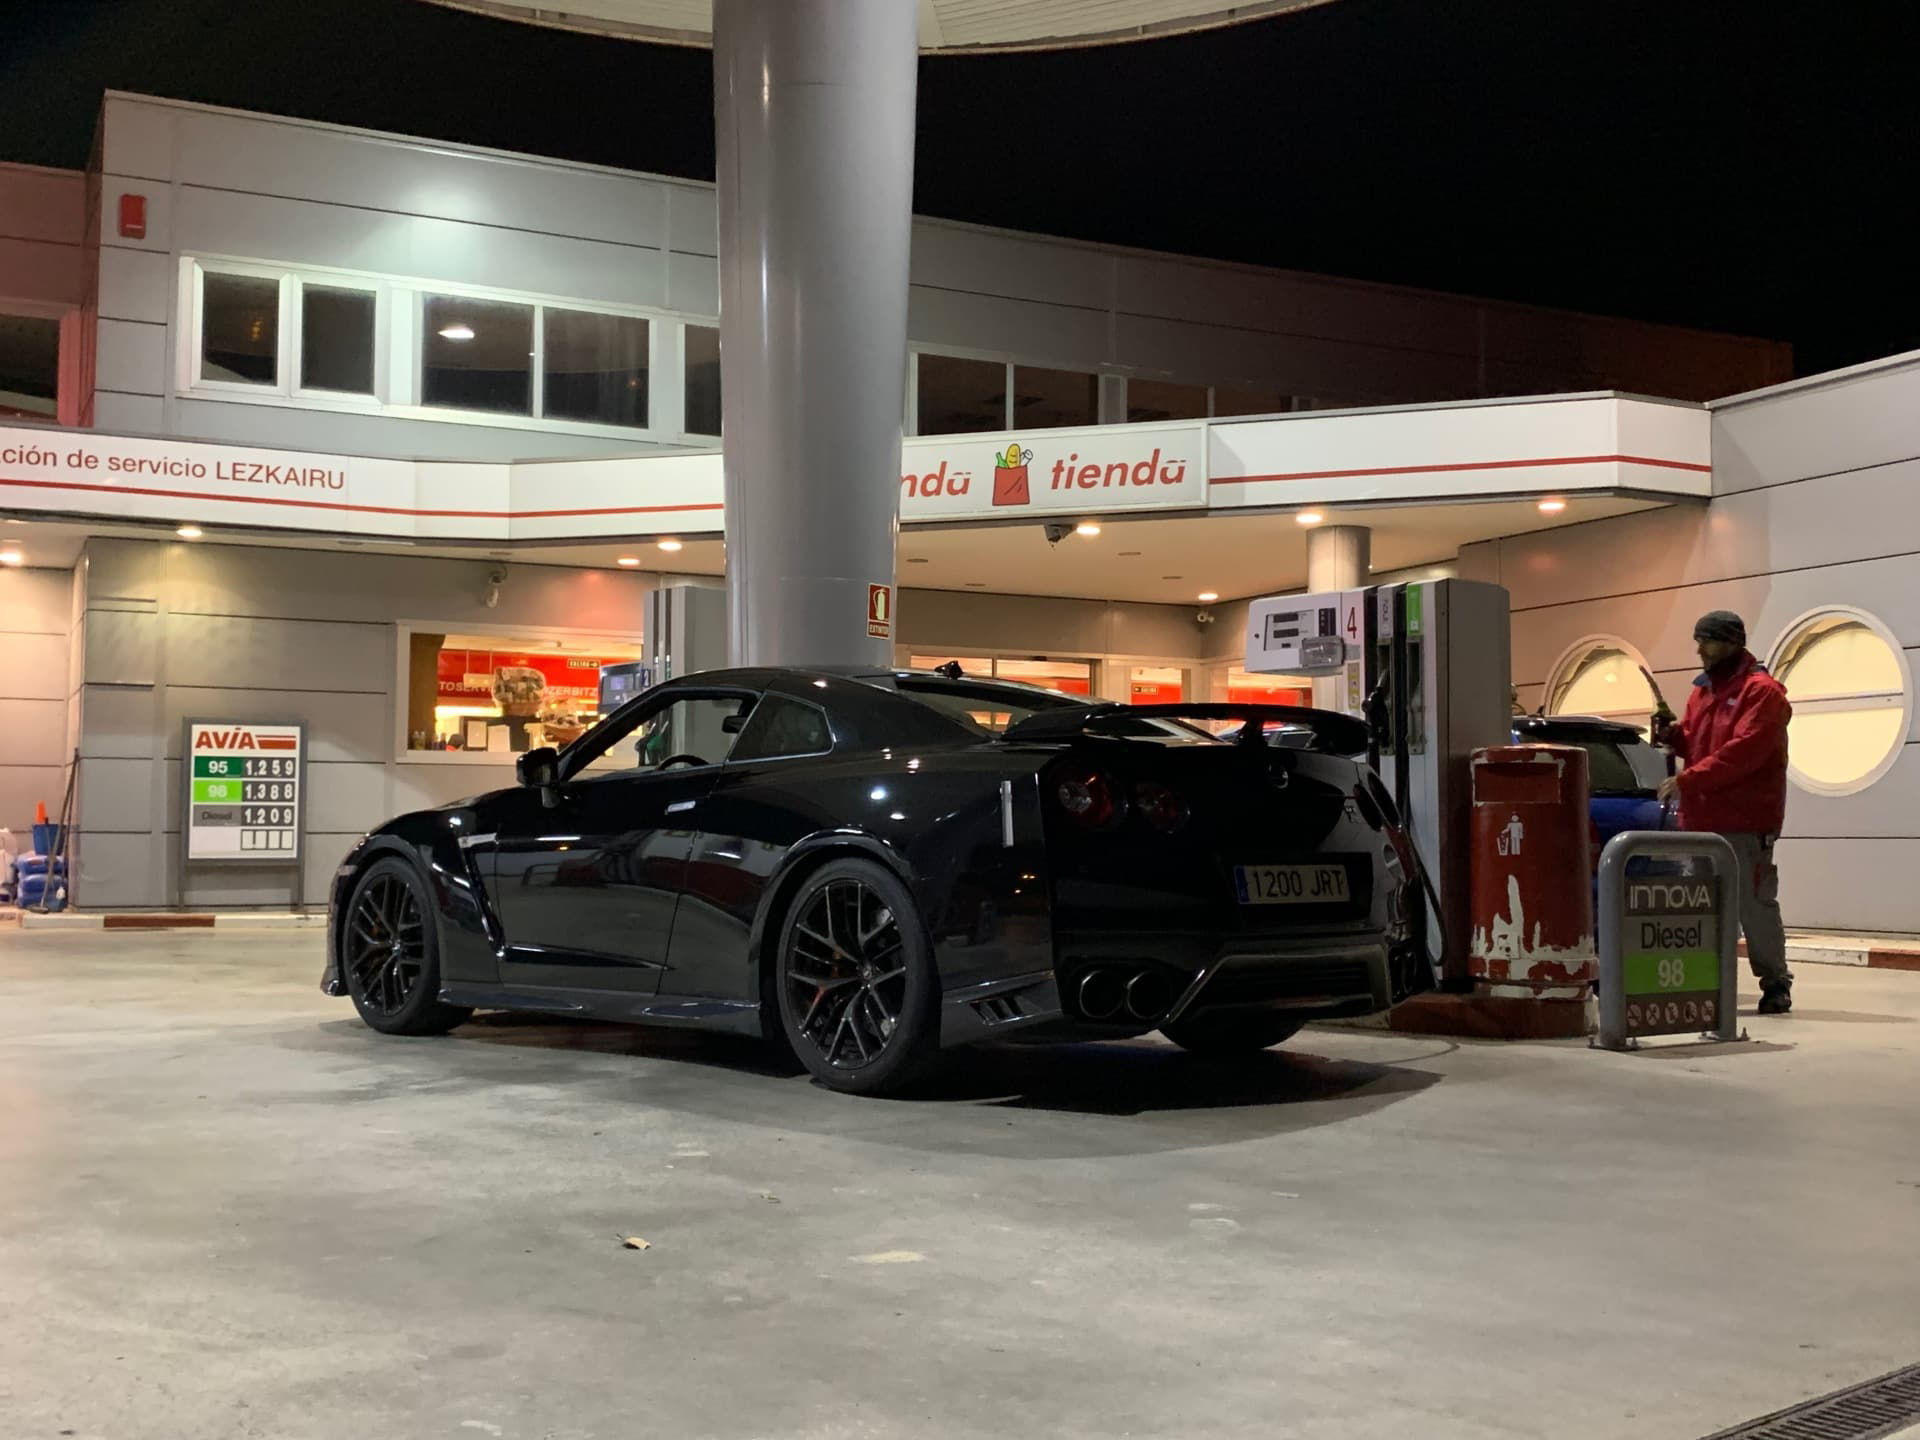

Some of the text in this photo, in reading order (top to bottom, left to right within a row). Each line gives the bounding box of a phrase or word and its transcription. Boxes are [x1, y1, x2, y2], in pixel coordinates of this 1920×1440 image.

[0, 444, 345, 491] ción de servicio LEZKAIRU
[1347, 606, 1358, 640] 4
[208, 760, 229, 775] 95
[1253, 869, 1303, 898] 1200
[1311, 869, 1344, 897] JRT
[1640, 920, 1702, 950] Diesel
[1657, 958, 1686, 988] 98
